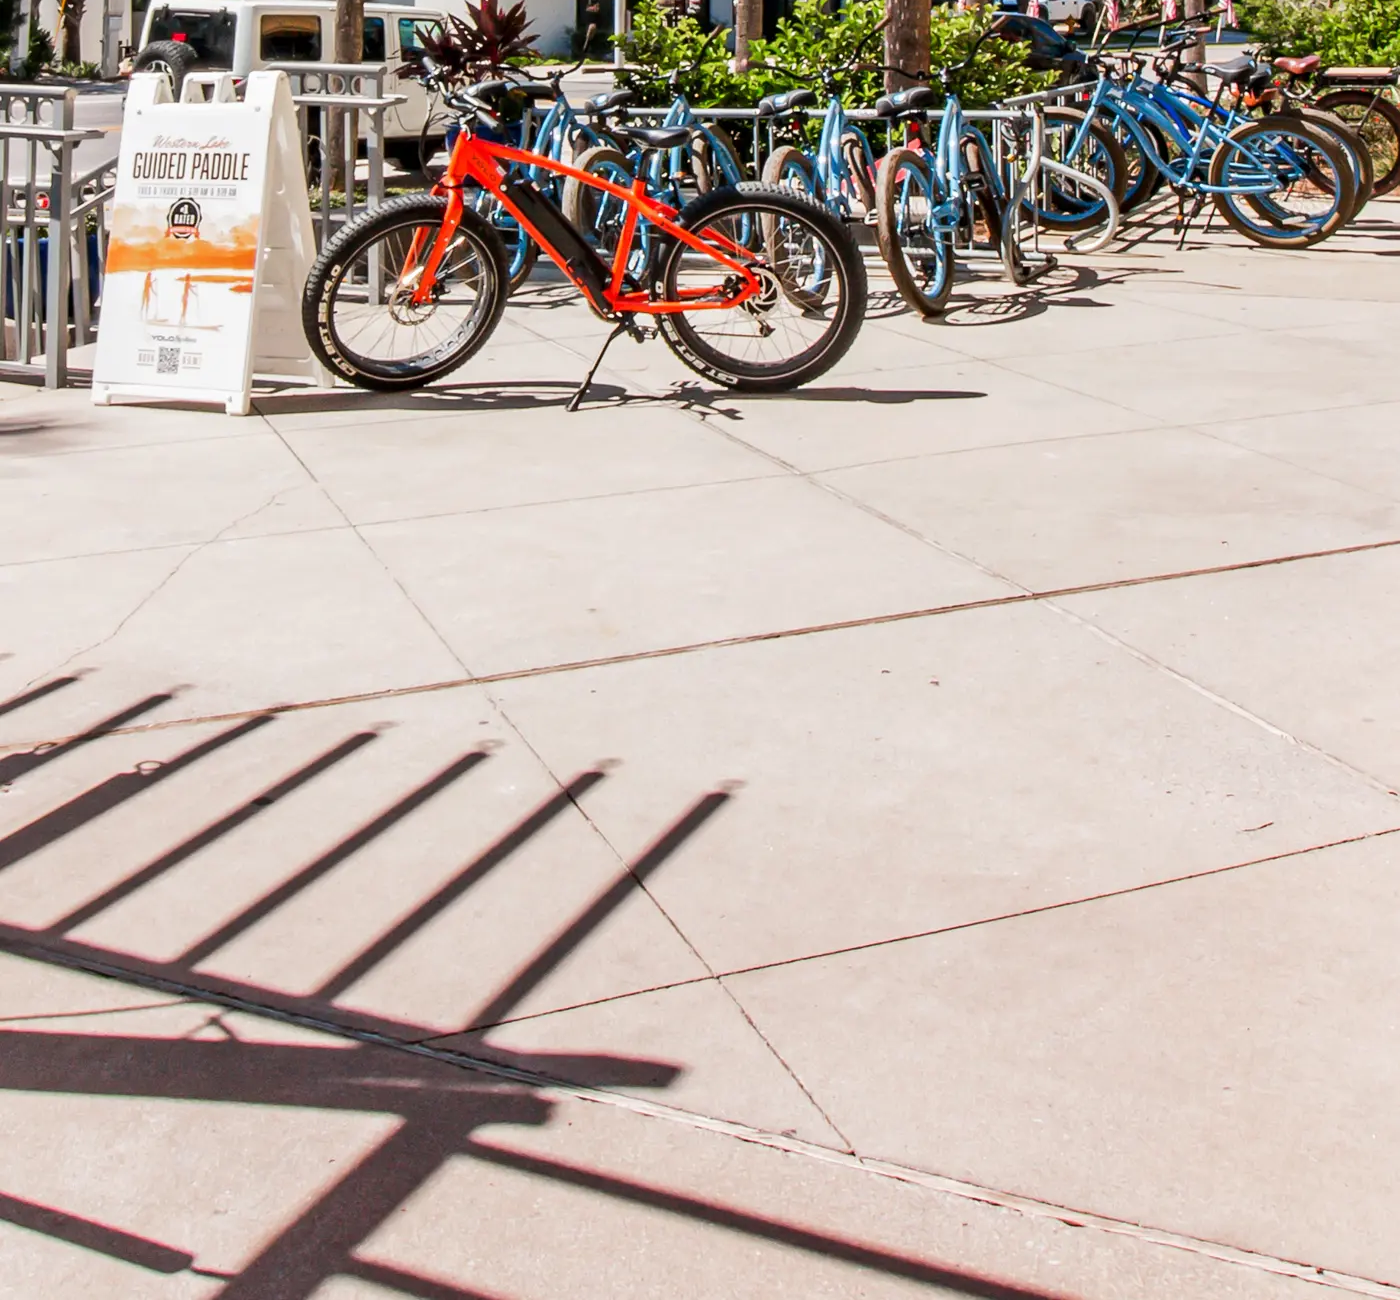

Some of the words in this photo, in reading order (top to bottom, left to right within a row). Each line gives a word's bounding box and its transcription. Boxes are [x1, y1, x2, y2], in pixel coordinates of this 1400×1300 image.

[153, 135, 200, 149] Western
[200, 135, 231, 150] Lake
[132, 152, 187, 180] GUIDED
[190, 153, 250, 180] PADDLE
[706, 369, 738, 384] CST
